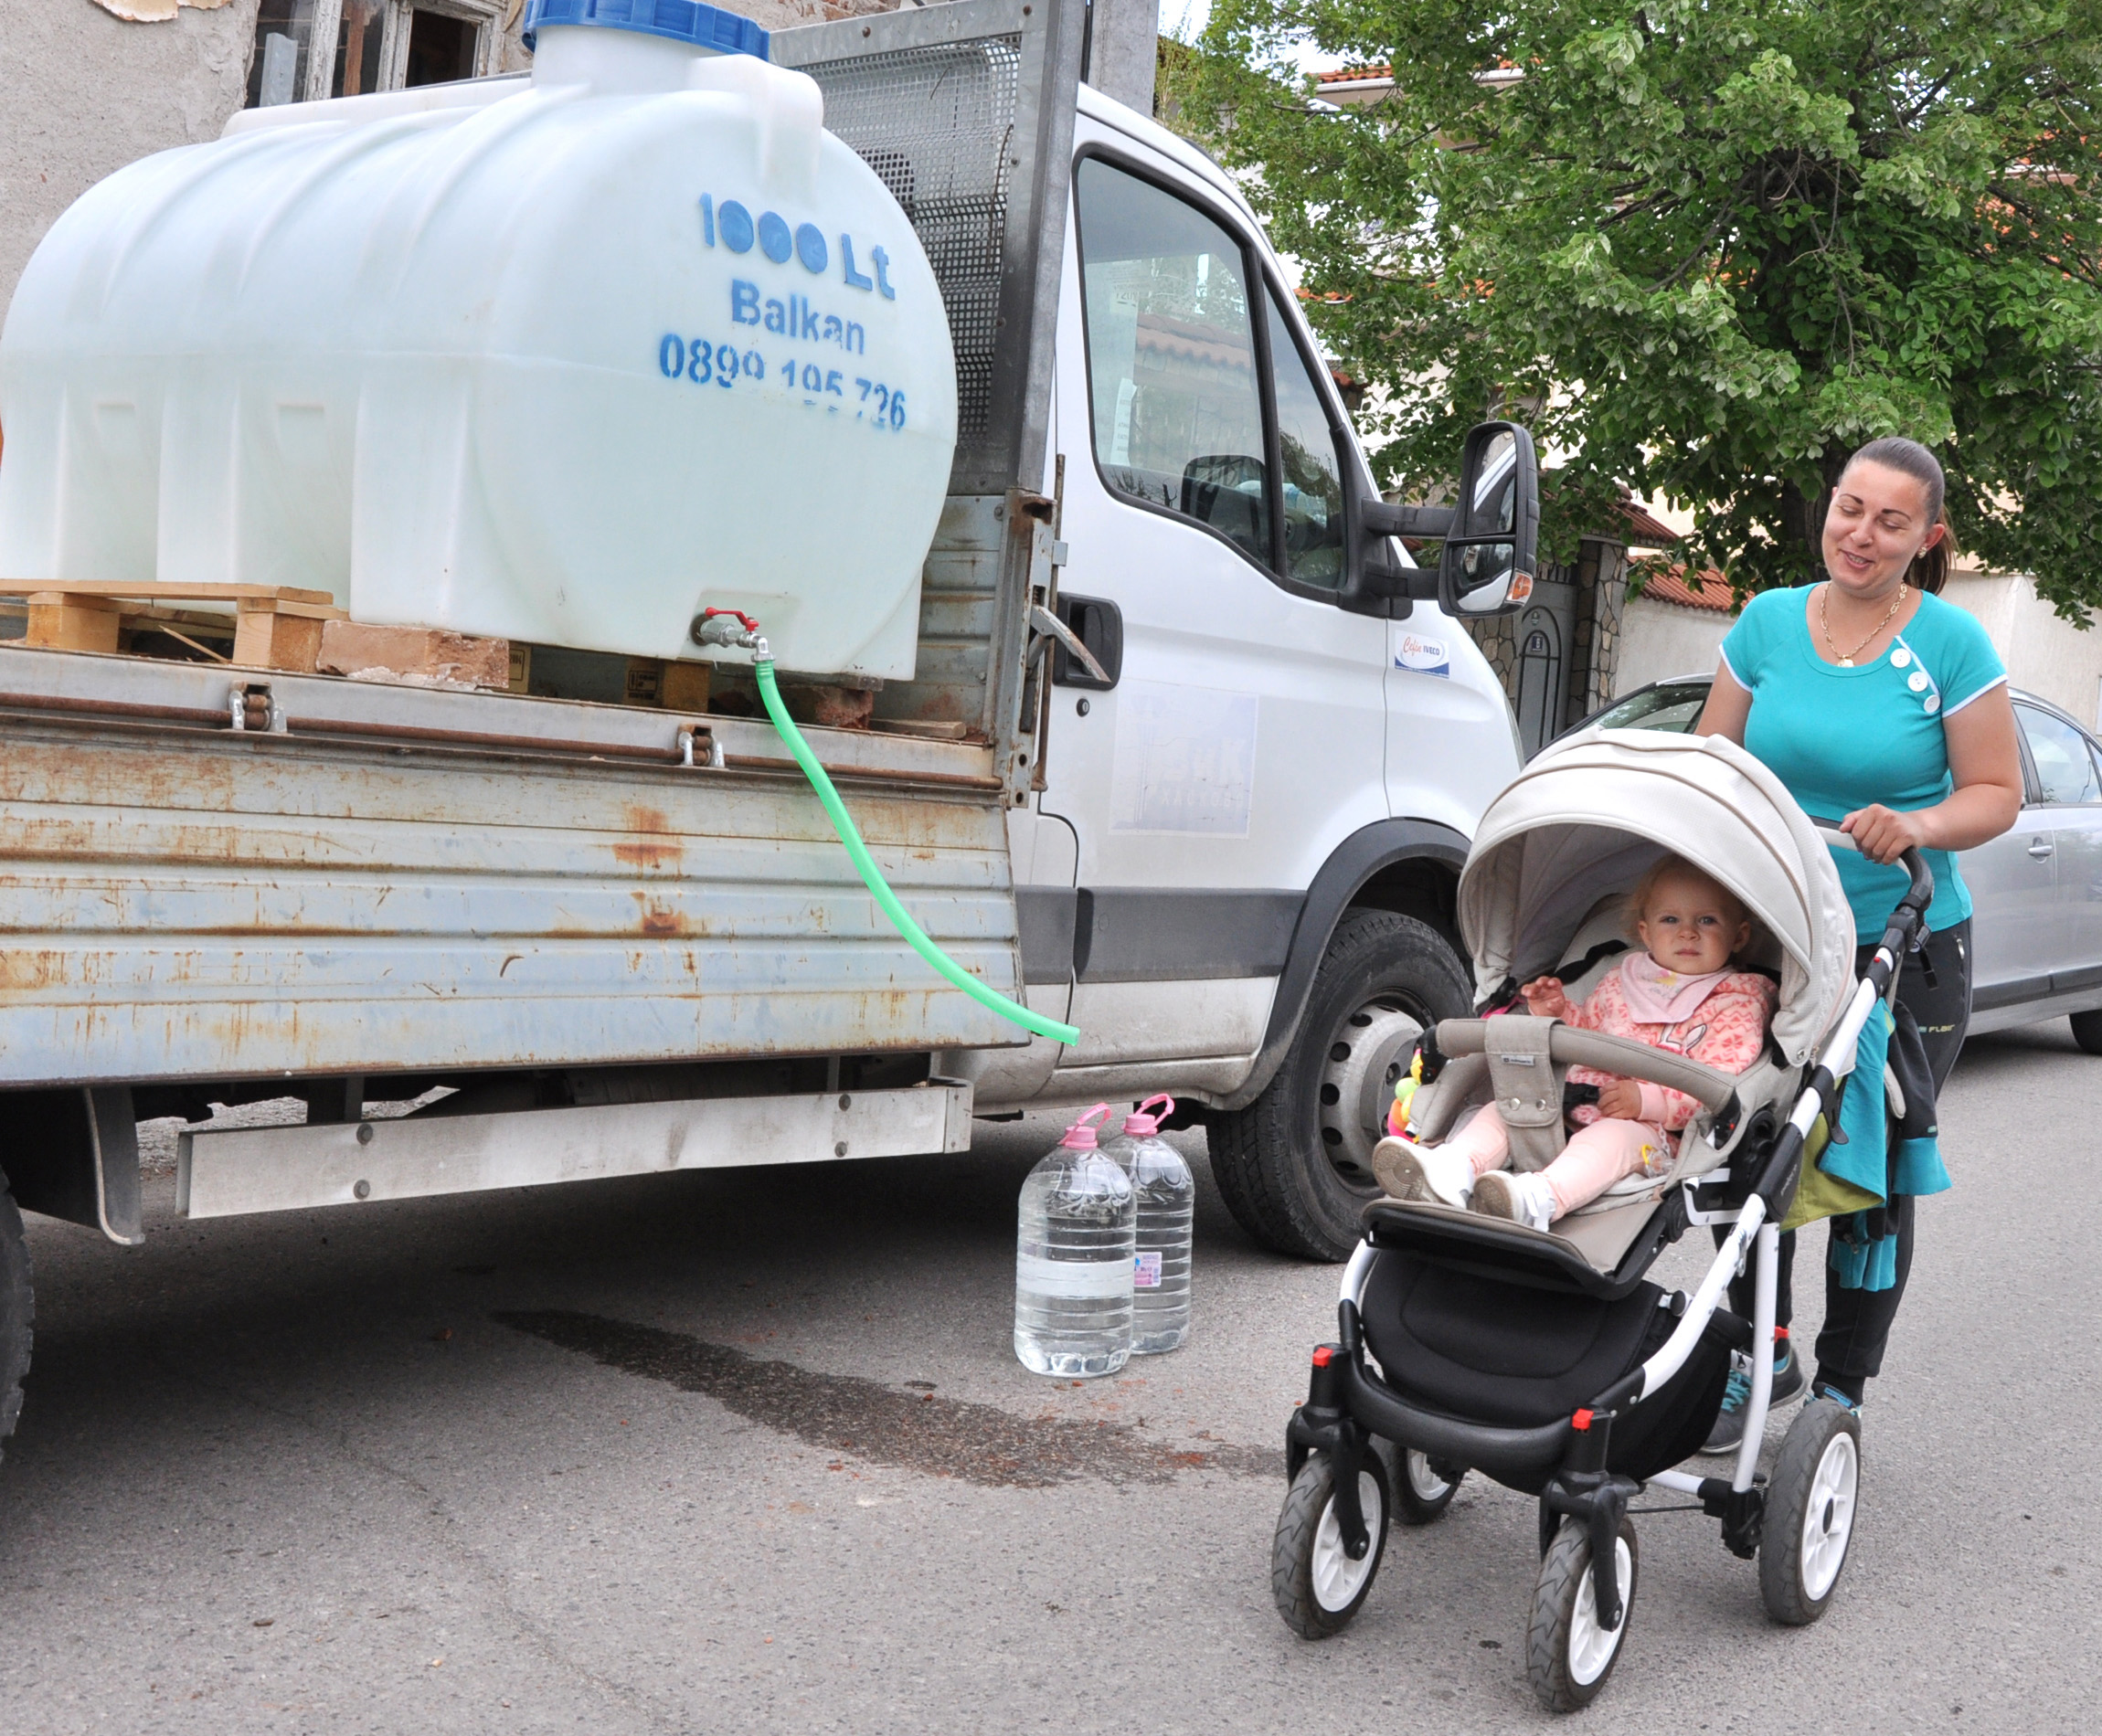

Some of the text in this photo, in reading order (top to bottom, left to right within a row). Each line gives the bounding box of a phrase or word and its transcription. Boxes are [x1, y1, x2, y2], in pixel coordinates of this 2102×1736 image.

[698, 192, 896, 301] 1000 Lt
[731, 278, 865, 355] Balkan
[1423, 645, 1440, 656] IVECO
